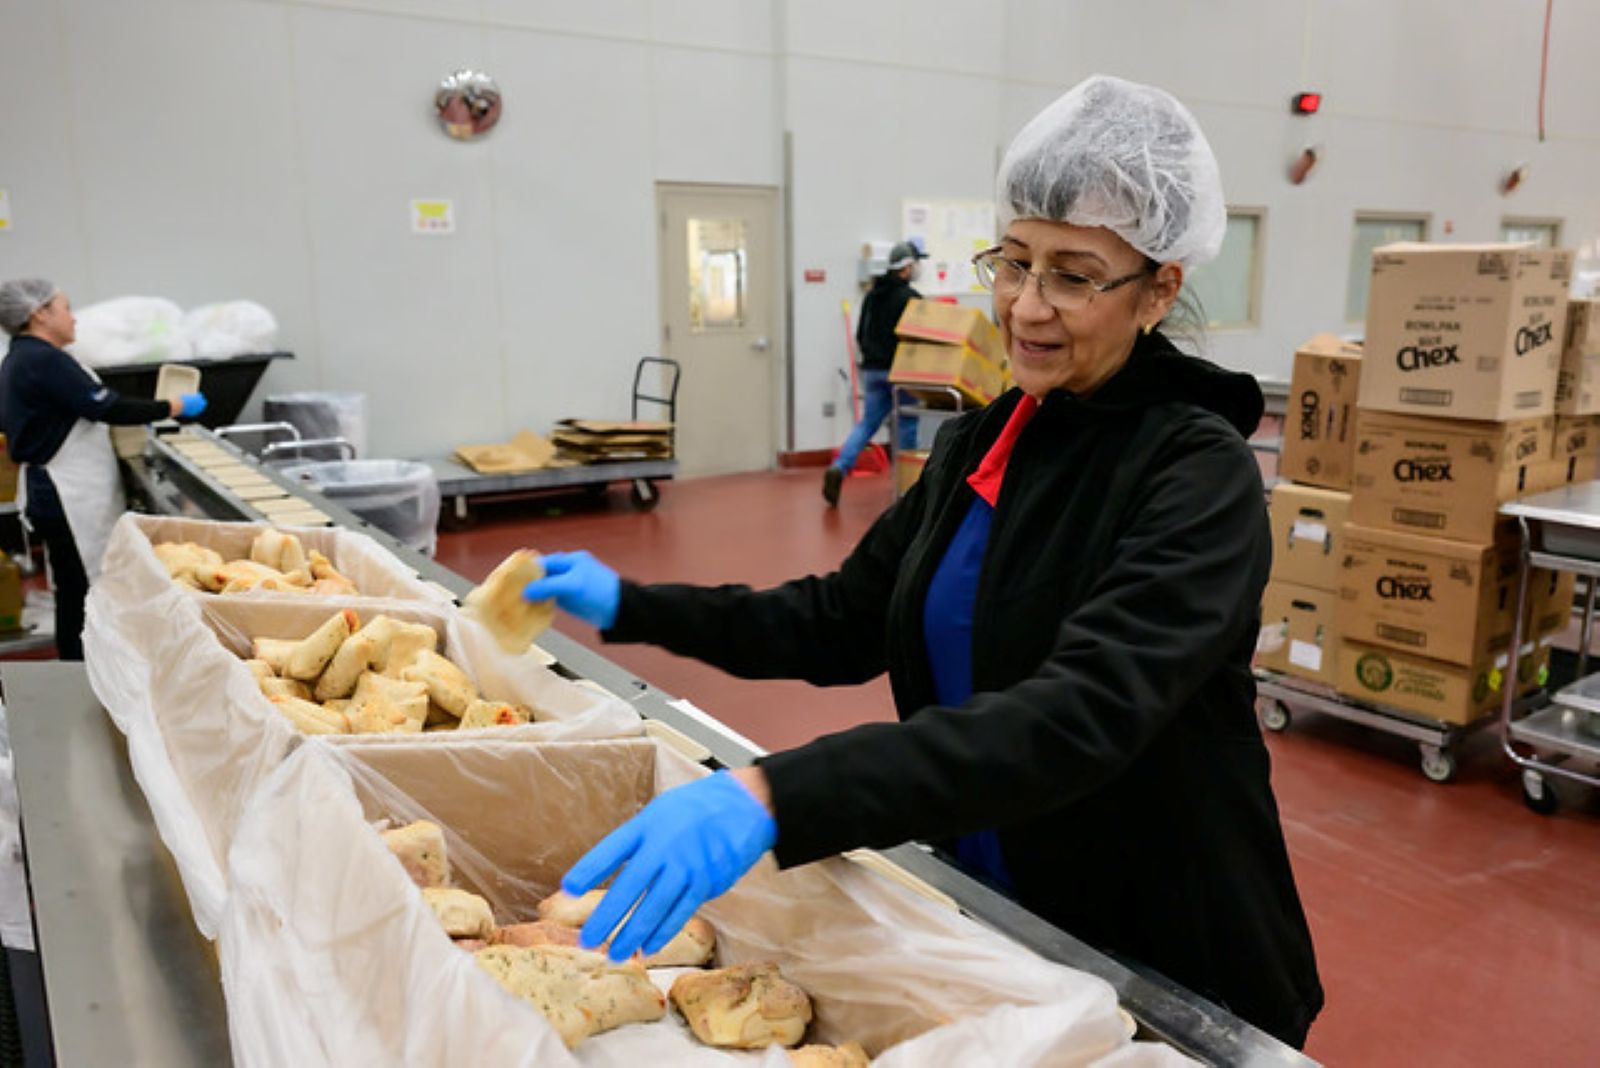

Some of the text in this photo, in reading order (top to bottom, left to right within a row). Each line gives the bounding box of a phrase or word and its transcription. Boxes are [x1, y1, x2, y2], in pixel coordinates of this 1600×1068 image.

[1515, 321, 1552, 356] Chex
[1397, 344, 1460, 371] Chex
[1301, 390, 1319, 440] Chex
[1393, 458, 1454, 482] Chex
[1376, 577, 1433, 602] Chex
